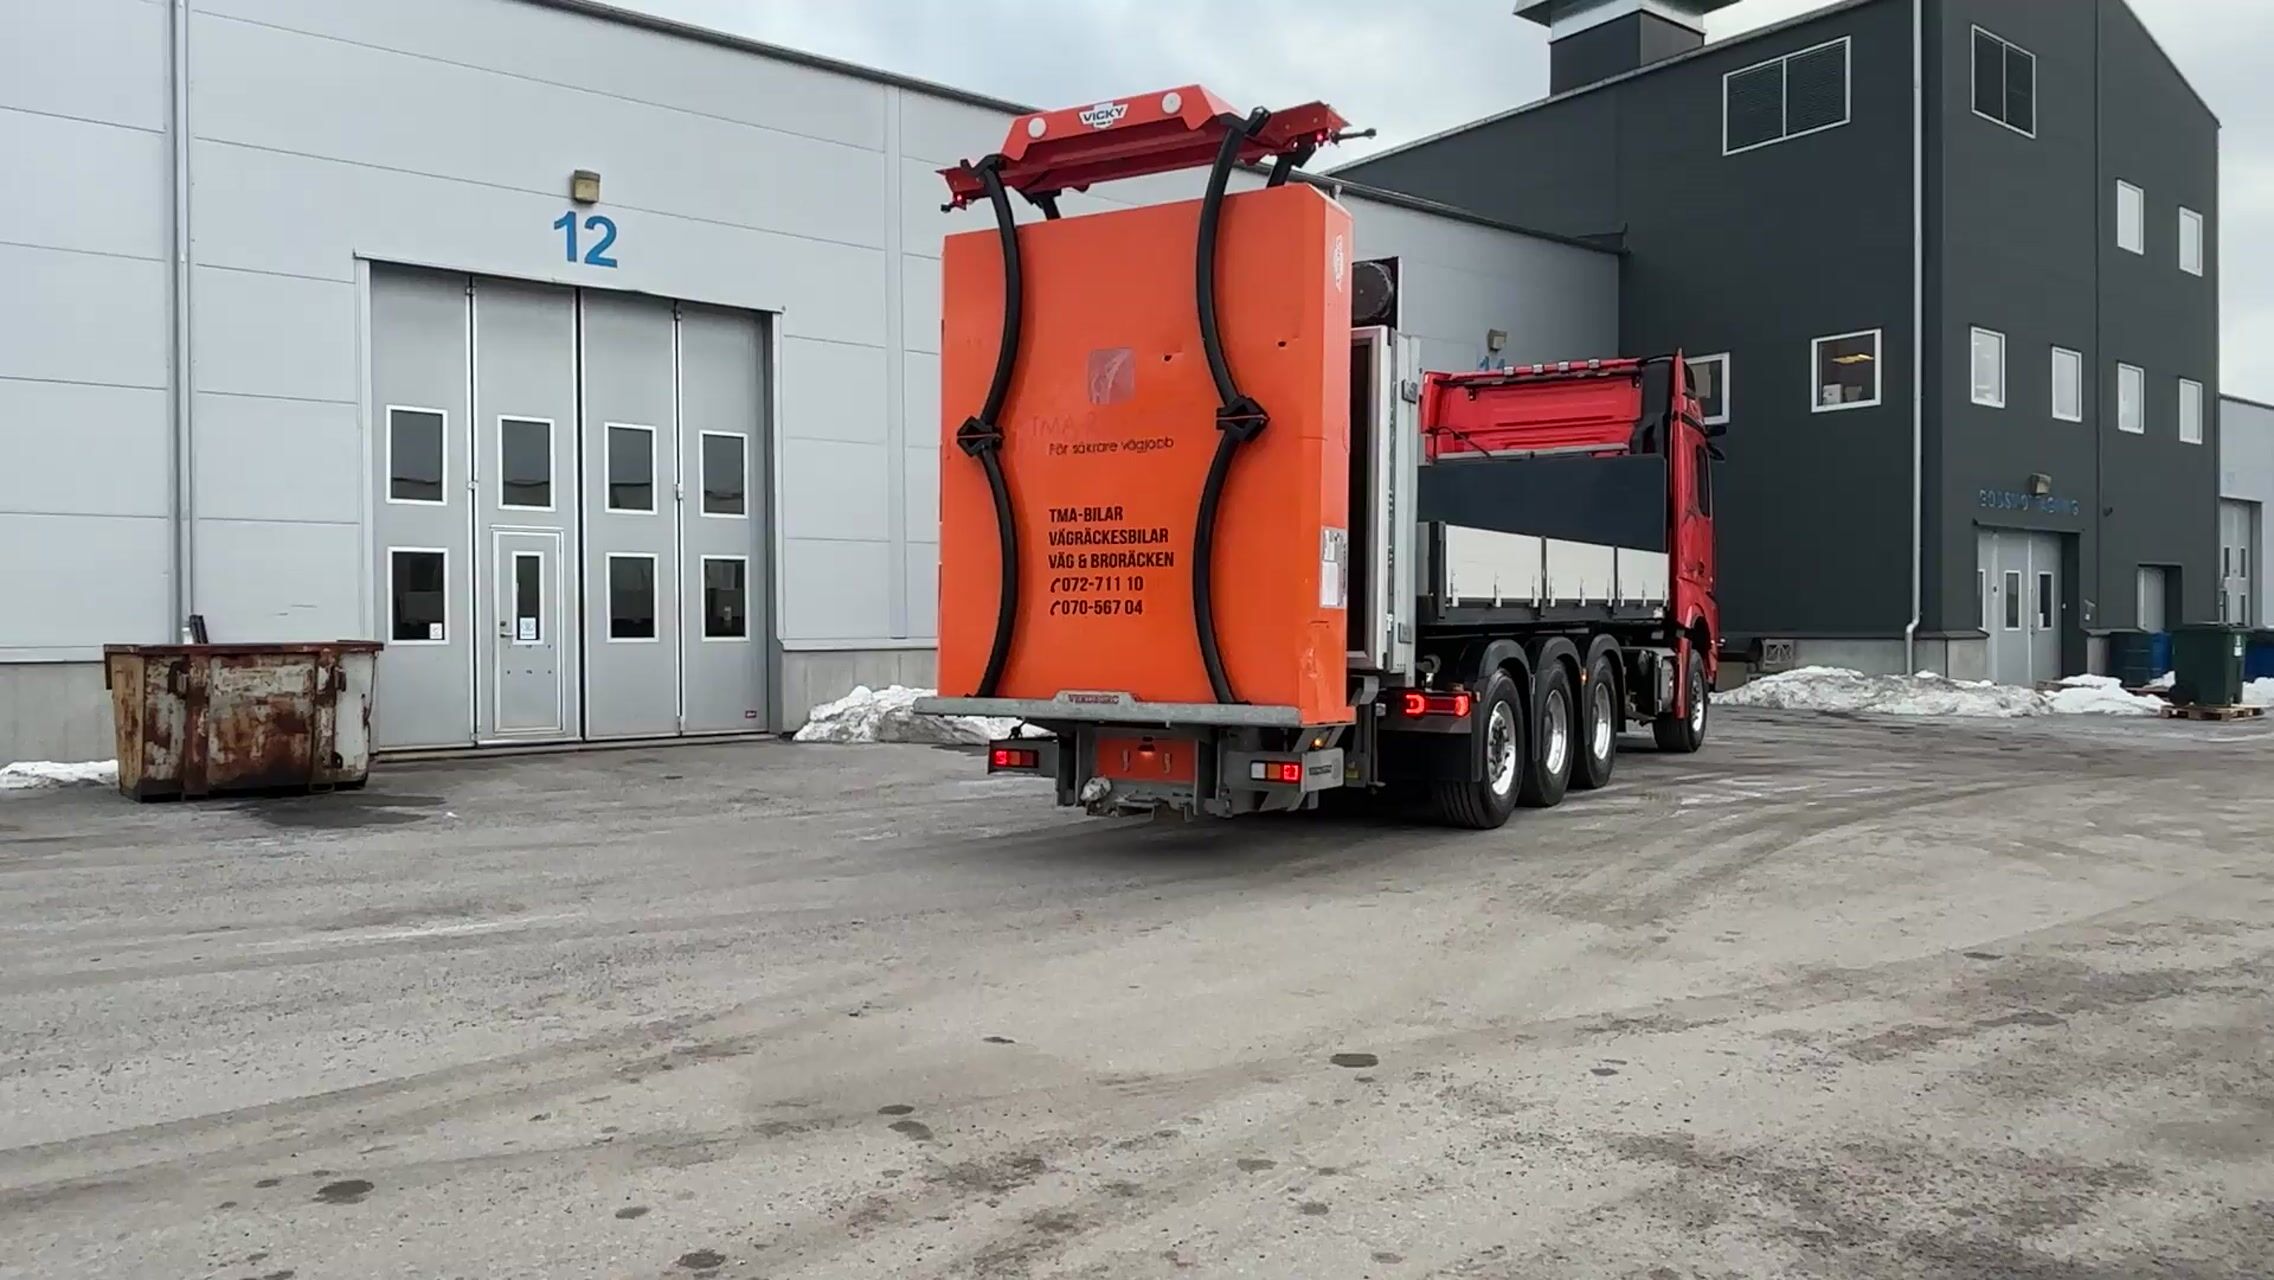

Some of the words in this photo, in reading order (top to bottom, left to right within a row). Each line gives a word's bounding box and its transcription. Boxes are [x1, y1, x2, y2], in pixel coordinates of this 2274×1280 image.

[1083, 106, 1124, 121] VICKY
[554, 211, 618, 268] 12
[1049, 506, 1123, 523] TMA-BILAR
[1049, 528, 1168, 546] VÄGRÄCKESBILAR
[1049, 553, 1074, 569] VÄG
[1078, 553, 1087, 568] &
[1090, 551, 1174, 568] BRORÄCKEN
[1061, 576, 1121, 592] 072-711
[1127, 576, 1144, 591] 10
[1061, 600, 1120, 615] 070-567
[1124, 600, 1143, 615] 04
